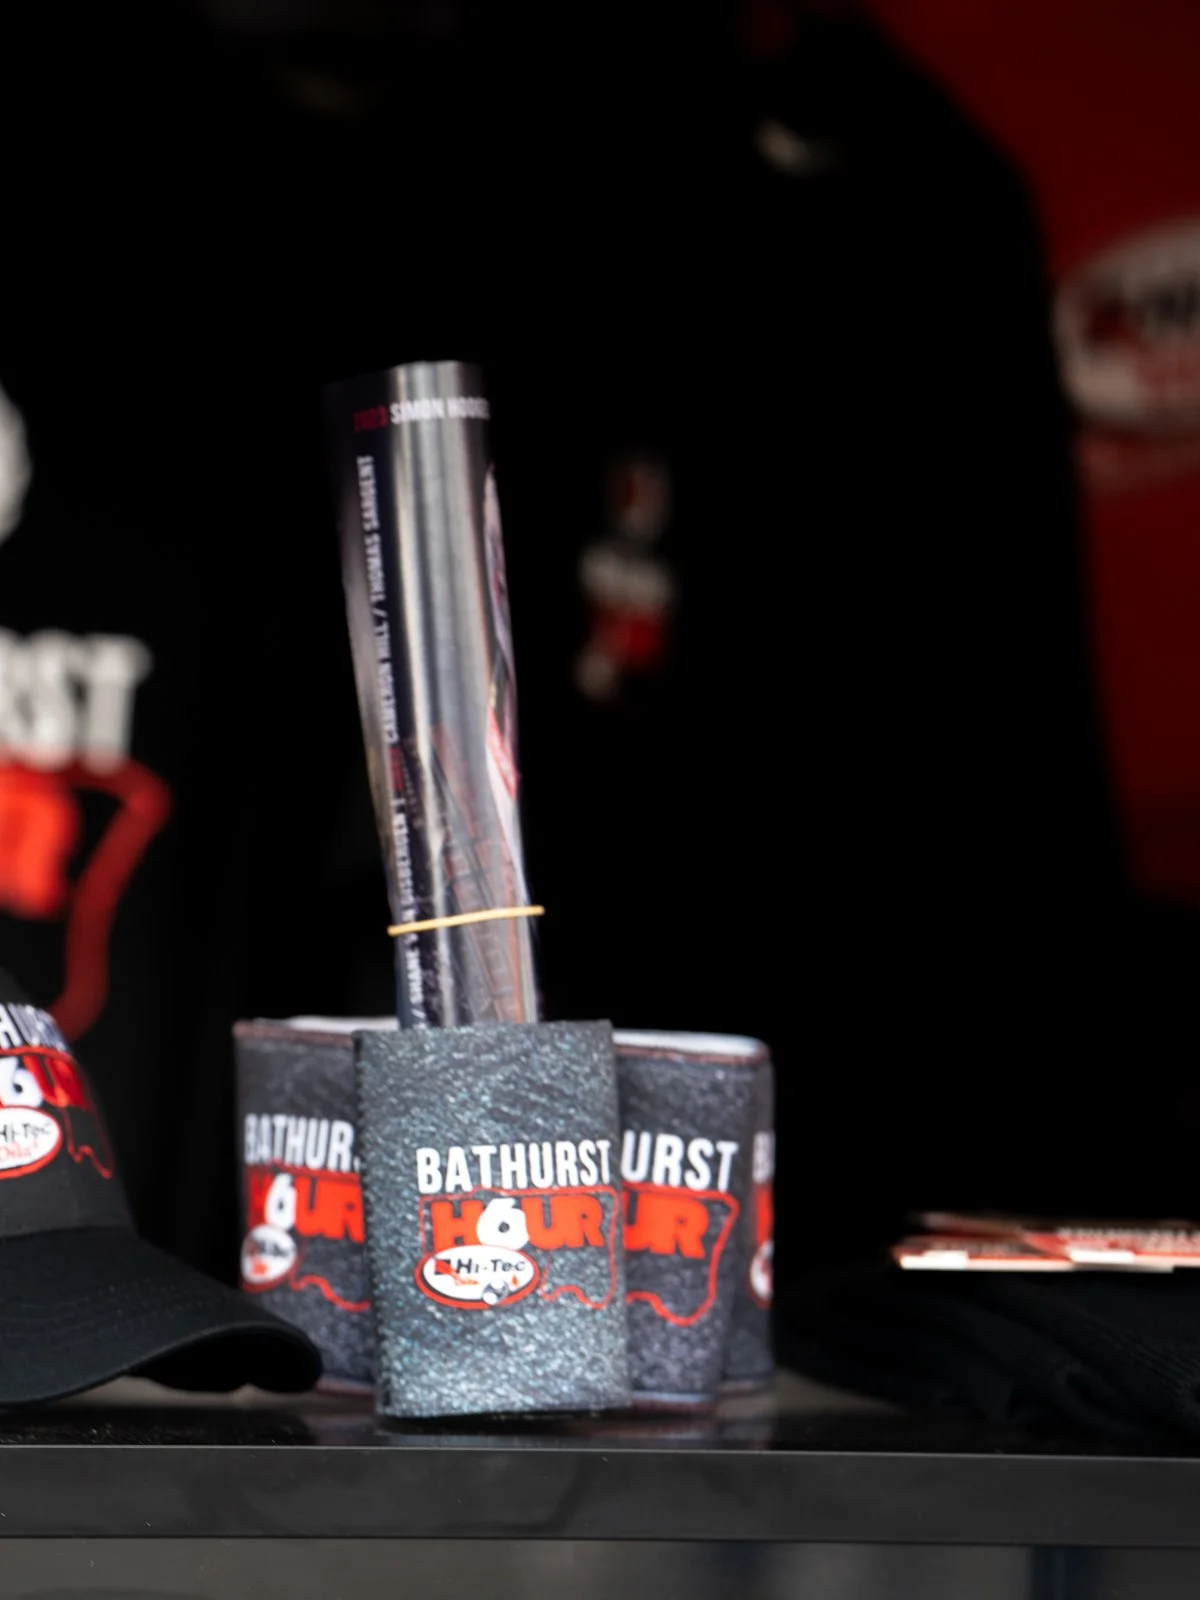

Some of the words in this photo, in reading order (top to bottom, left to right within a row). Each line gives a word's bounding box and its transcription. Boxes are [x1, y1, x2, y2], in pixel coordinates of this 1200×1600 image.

[356, 455, 380, 532] SARGENT
[364, 533, 386, 602] THOMAS
[373, 622, 392, 659] HILL
[376, 661, 399, 743] CAMERON
[401, 908, 419, 945] VN
[405, 947, 425, 1005] SHANE
[244, 1113, 363, 1173] BATHUR
[416, 1140, 611, 1195] BATHURST
